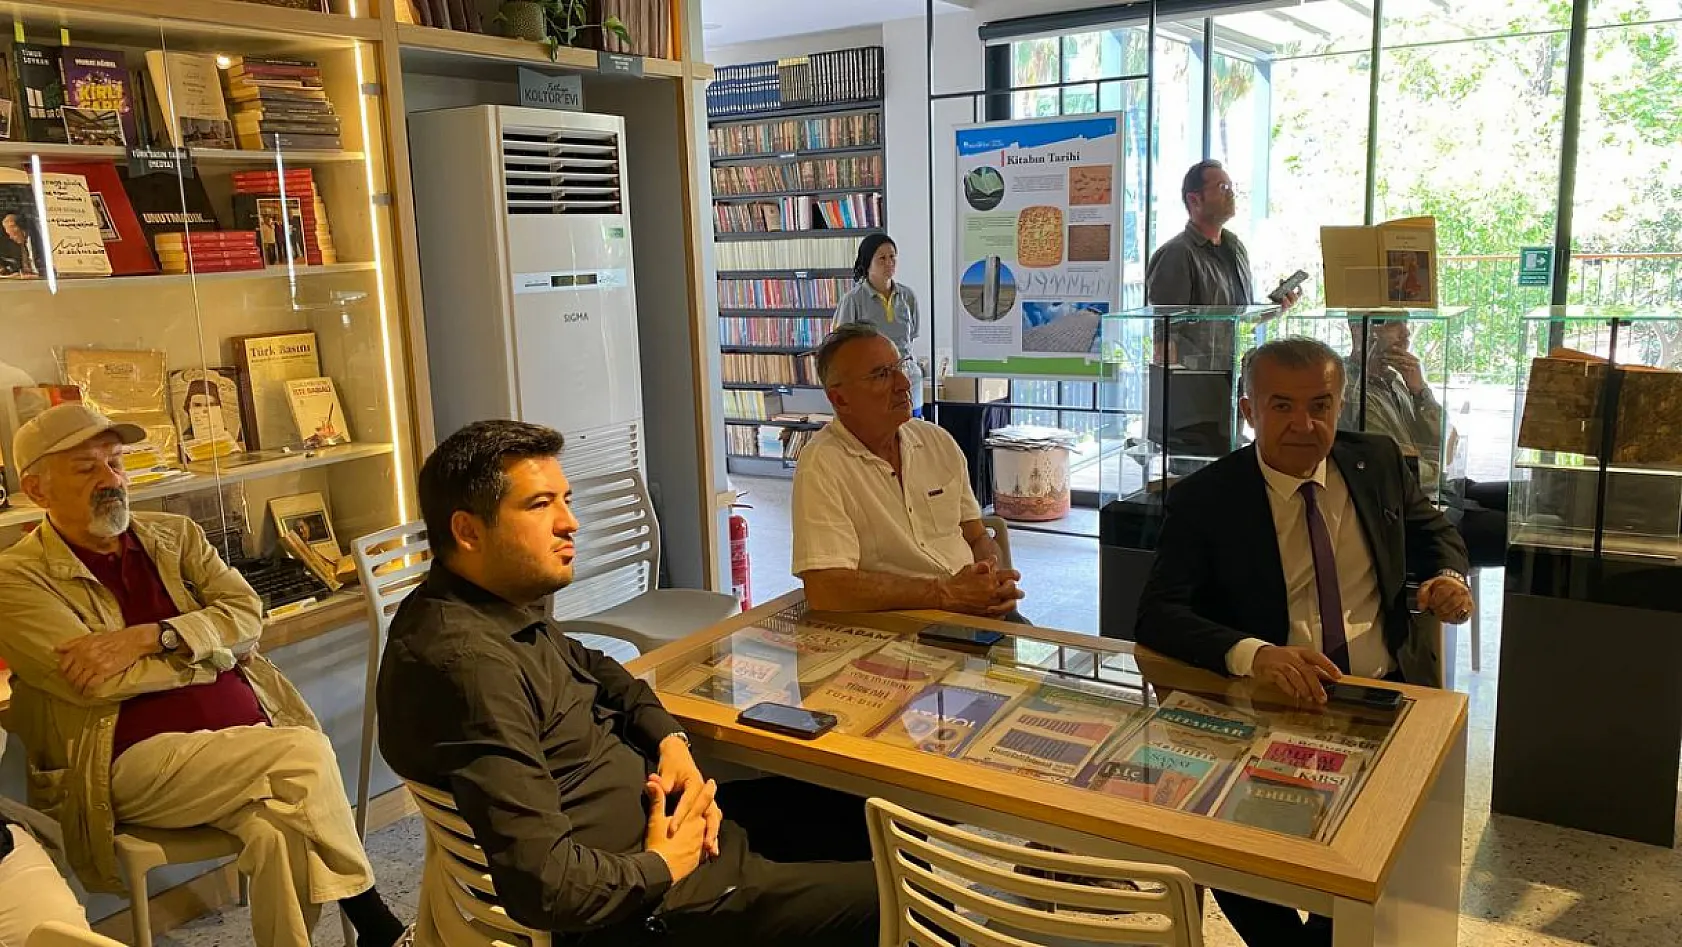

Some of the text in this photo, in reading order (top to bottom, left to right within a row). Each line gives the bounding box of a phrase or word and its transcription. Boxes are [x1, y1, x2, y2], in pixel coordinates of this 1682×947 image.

[1007, 151, 1081, 166] Kitabın Tarihi
[564, 312, 589, 323] SIGMA
